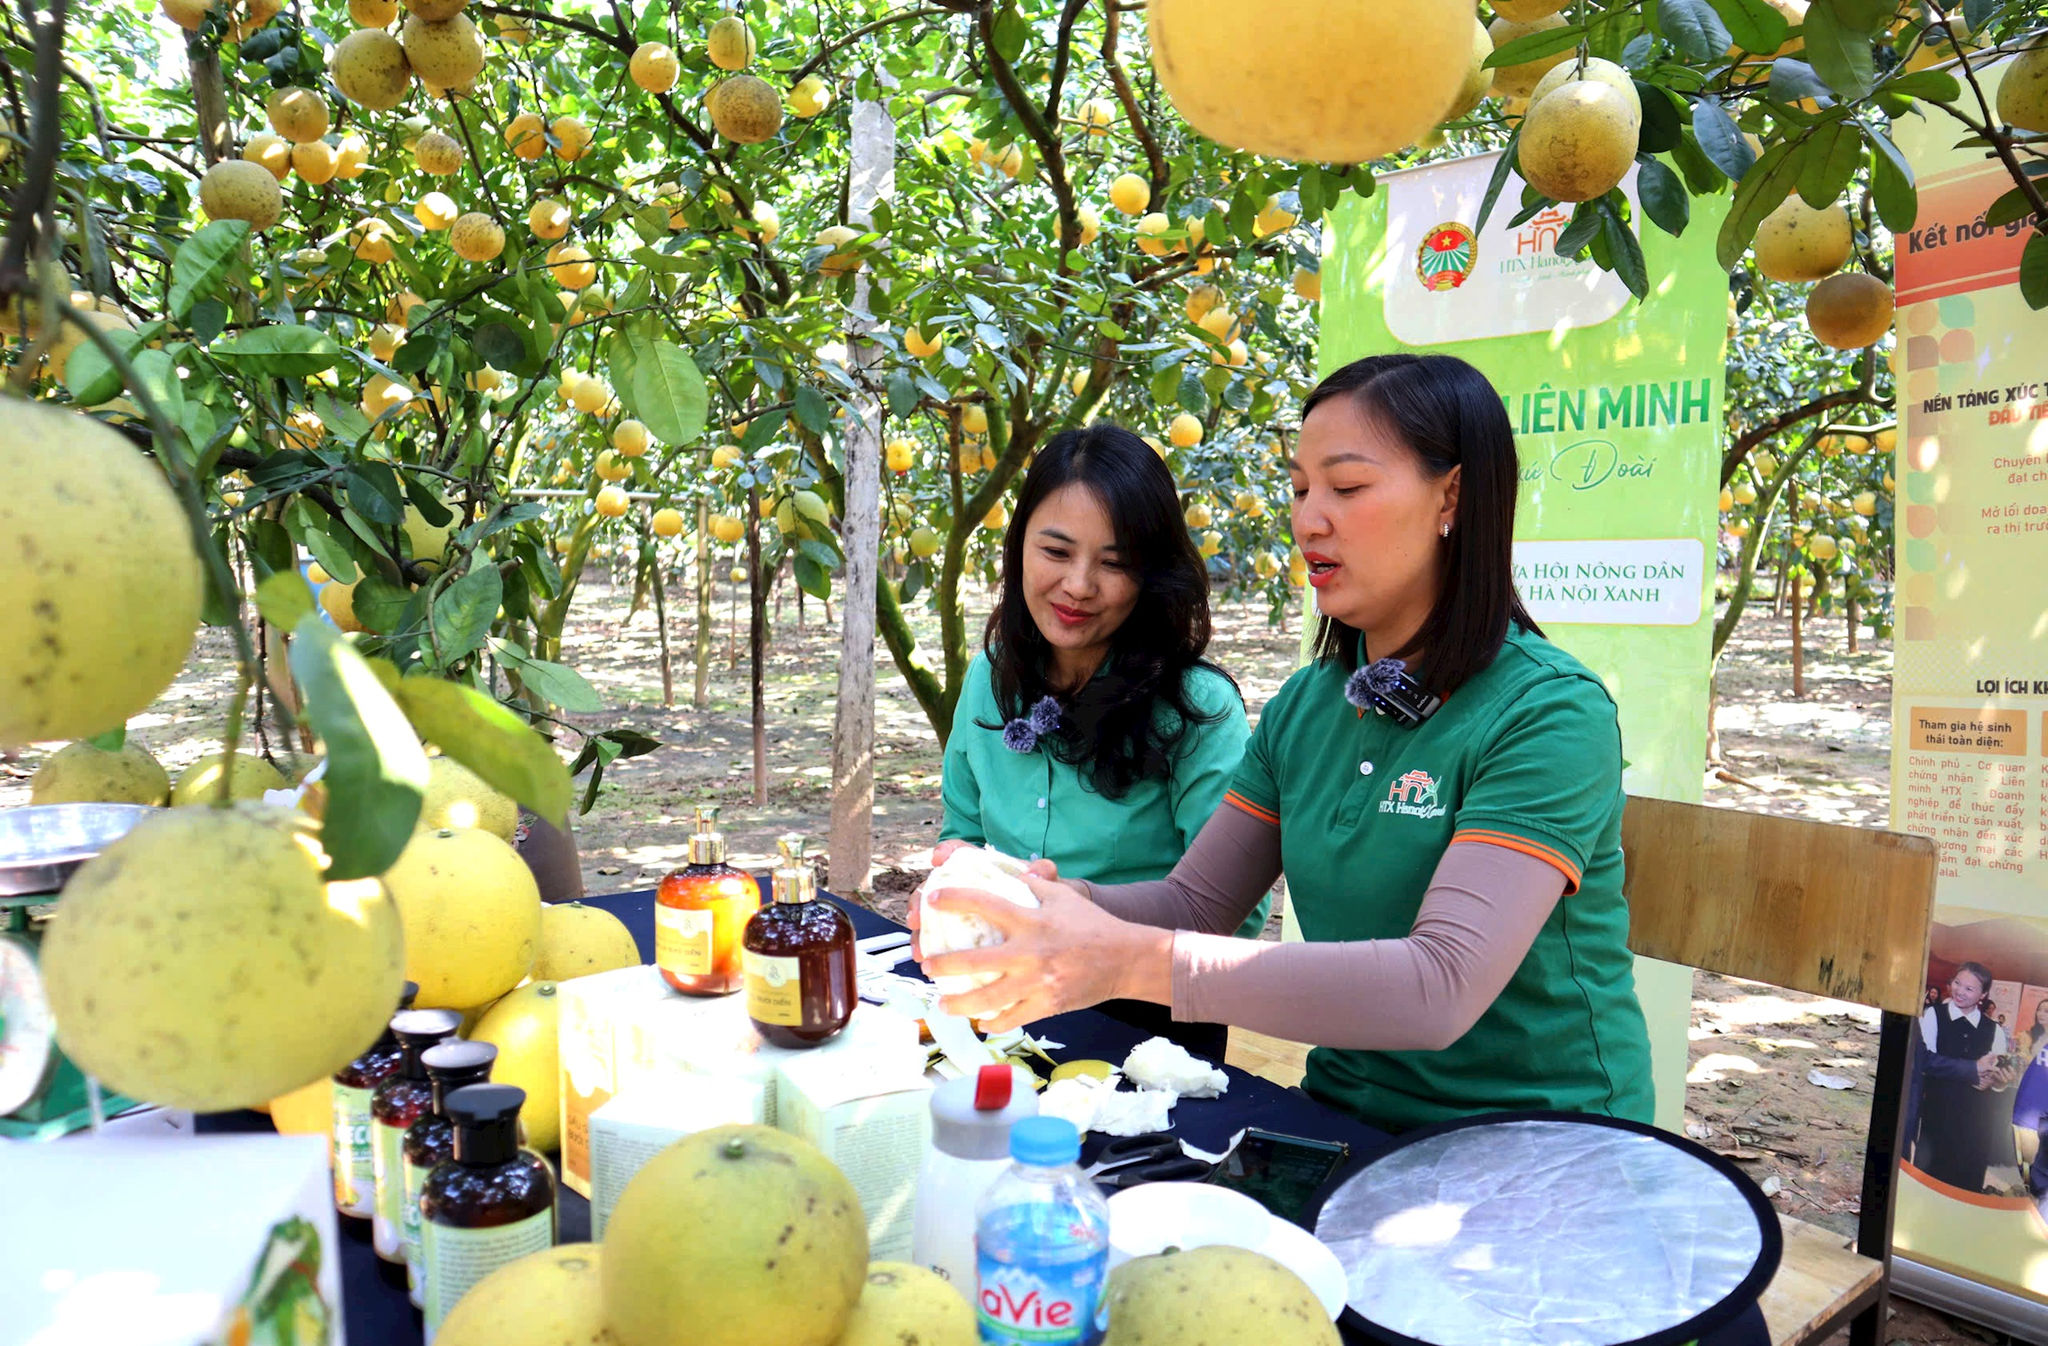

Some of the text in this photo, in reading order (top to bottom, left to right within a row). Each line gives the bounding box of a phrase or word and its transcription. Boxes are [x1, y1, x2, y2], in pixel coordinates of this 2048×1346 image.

[1909, 222, 1948, 254] Kết
[1597, 378, 1711, 430] MINH
[1957, 388, 2000, 408] TẢNG
[2005, 383, 2039, 402] XÚC
[1550, 439, 1657, 490] Đoài
[2008, 472, 2028, 485] đạt
[1981, 502, 2048, 519] Mở lối doa
[1987, 525, 2000, 535] ra
[2005, 521, 2020, 536] thị
[1534, 561, 1569, 582] HỘI
[1576, 560, 1636, 580] NÔNG
[1643, 560, 1685, 580] DÂN
[1529, 583, 1555, 601] HÀ
[1561, 583, 1597, 605] NỘI
[1603, 585, 1659, 603] XANH
[2005, 677, 2028, 694] ÍCH
[1918, 719, 2012, 734] Tham gia hệ sinh
[1926, 733, 2004, 749] thái toàn diện:
[1998, 763, 2025, 773] quan
[1908, 783, 1931, 793] minh
[1941, 785, 1962, 796] HTX
[1990, 788, 2025, 801] Doanh
[1938, 841, 1968, 853] ương
[1939, 851, 1957, 864] ẩm
[1939, 867, 1960, 878] alal.
[981, 1282, 1073, 1328] aVie
